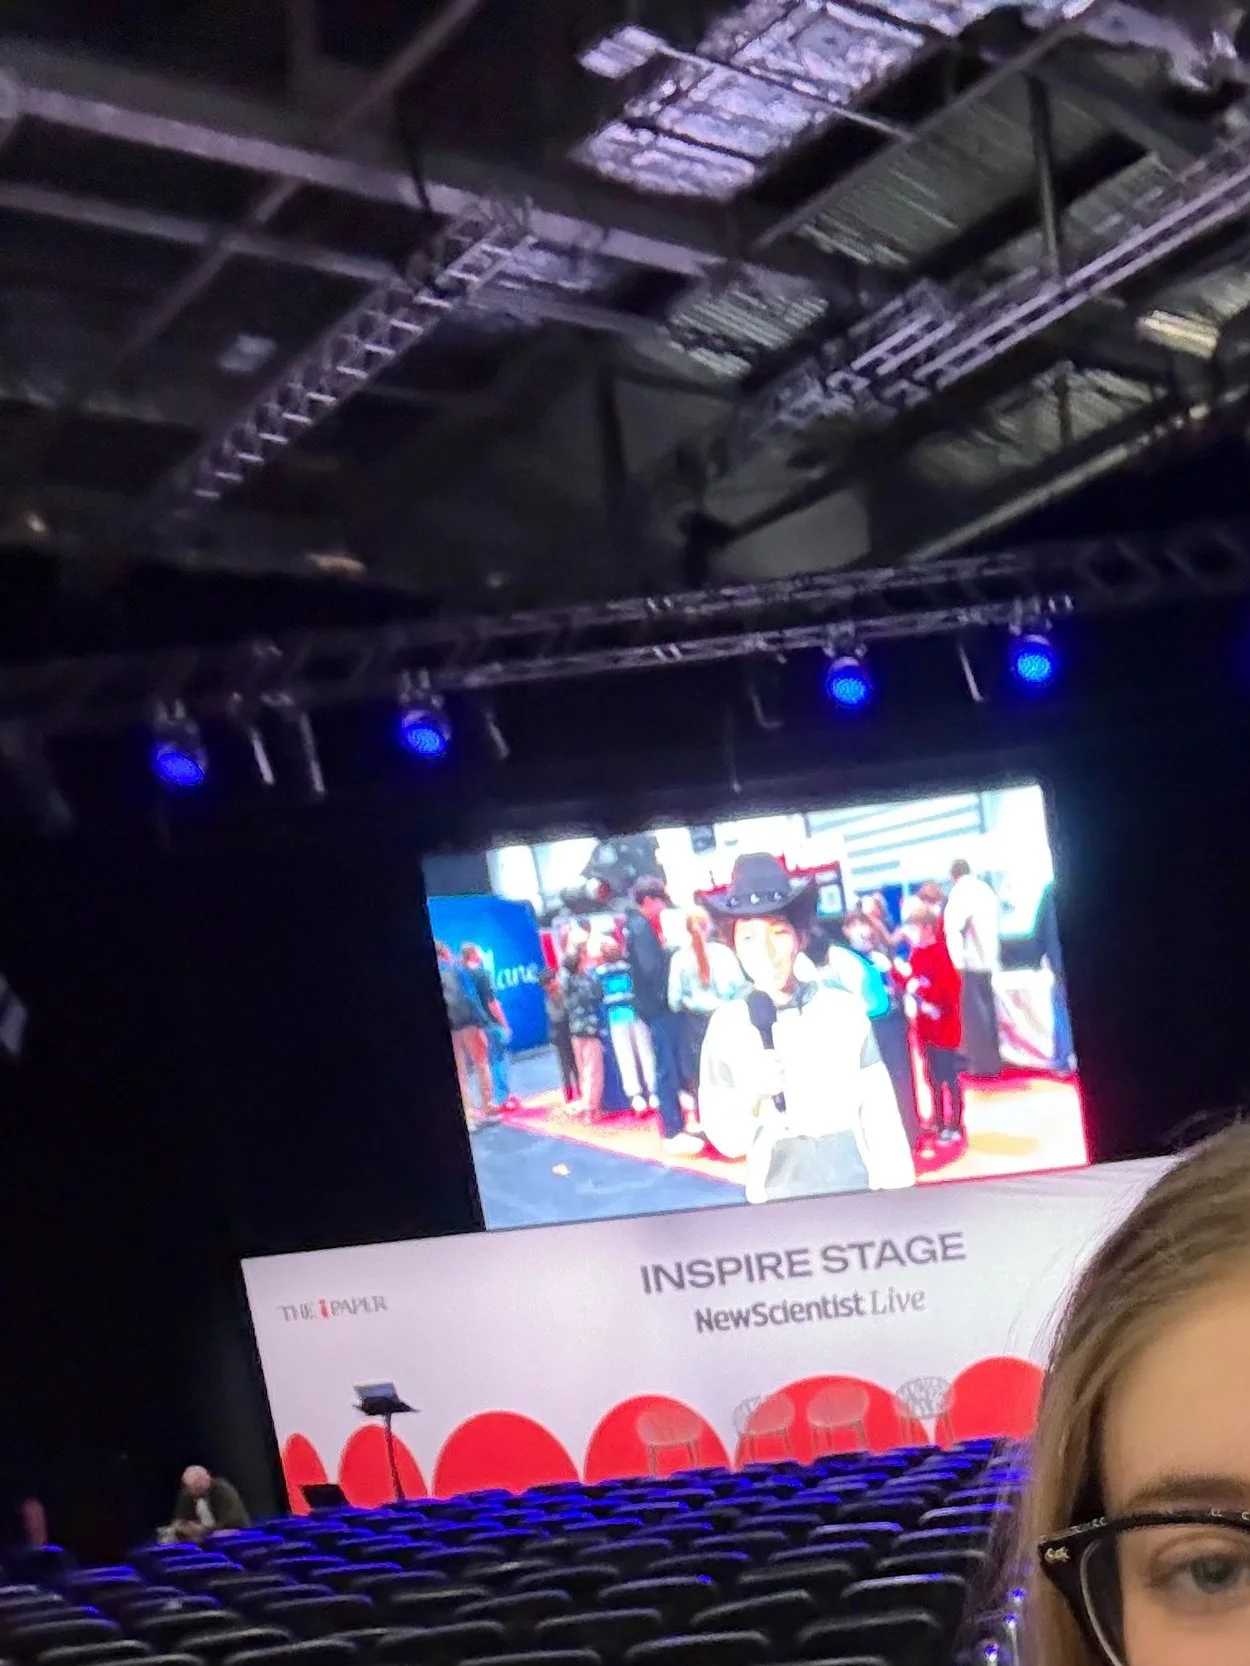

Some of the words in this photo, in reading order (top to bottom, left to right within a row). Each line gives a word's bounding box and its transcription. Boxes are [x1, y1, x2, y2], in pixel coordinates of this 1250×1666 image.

[639, 1248, 814, 1294] INSPIRE
[820, 1232, 968, 1274] STAGE
[694, 1293, 864, 1333] NewScientist
[871, 1286, 927, 1316] Live
